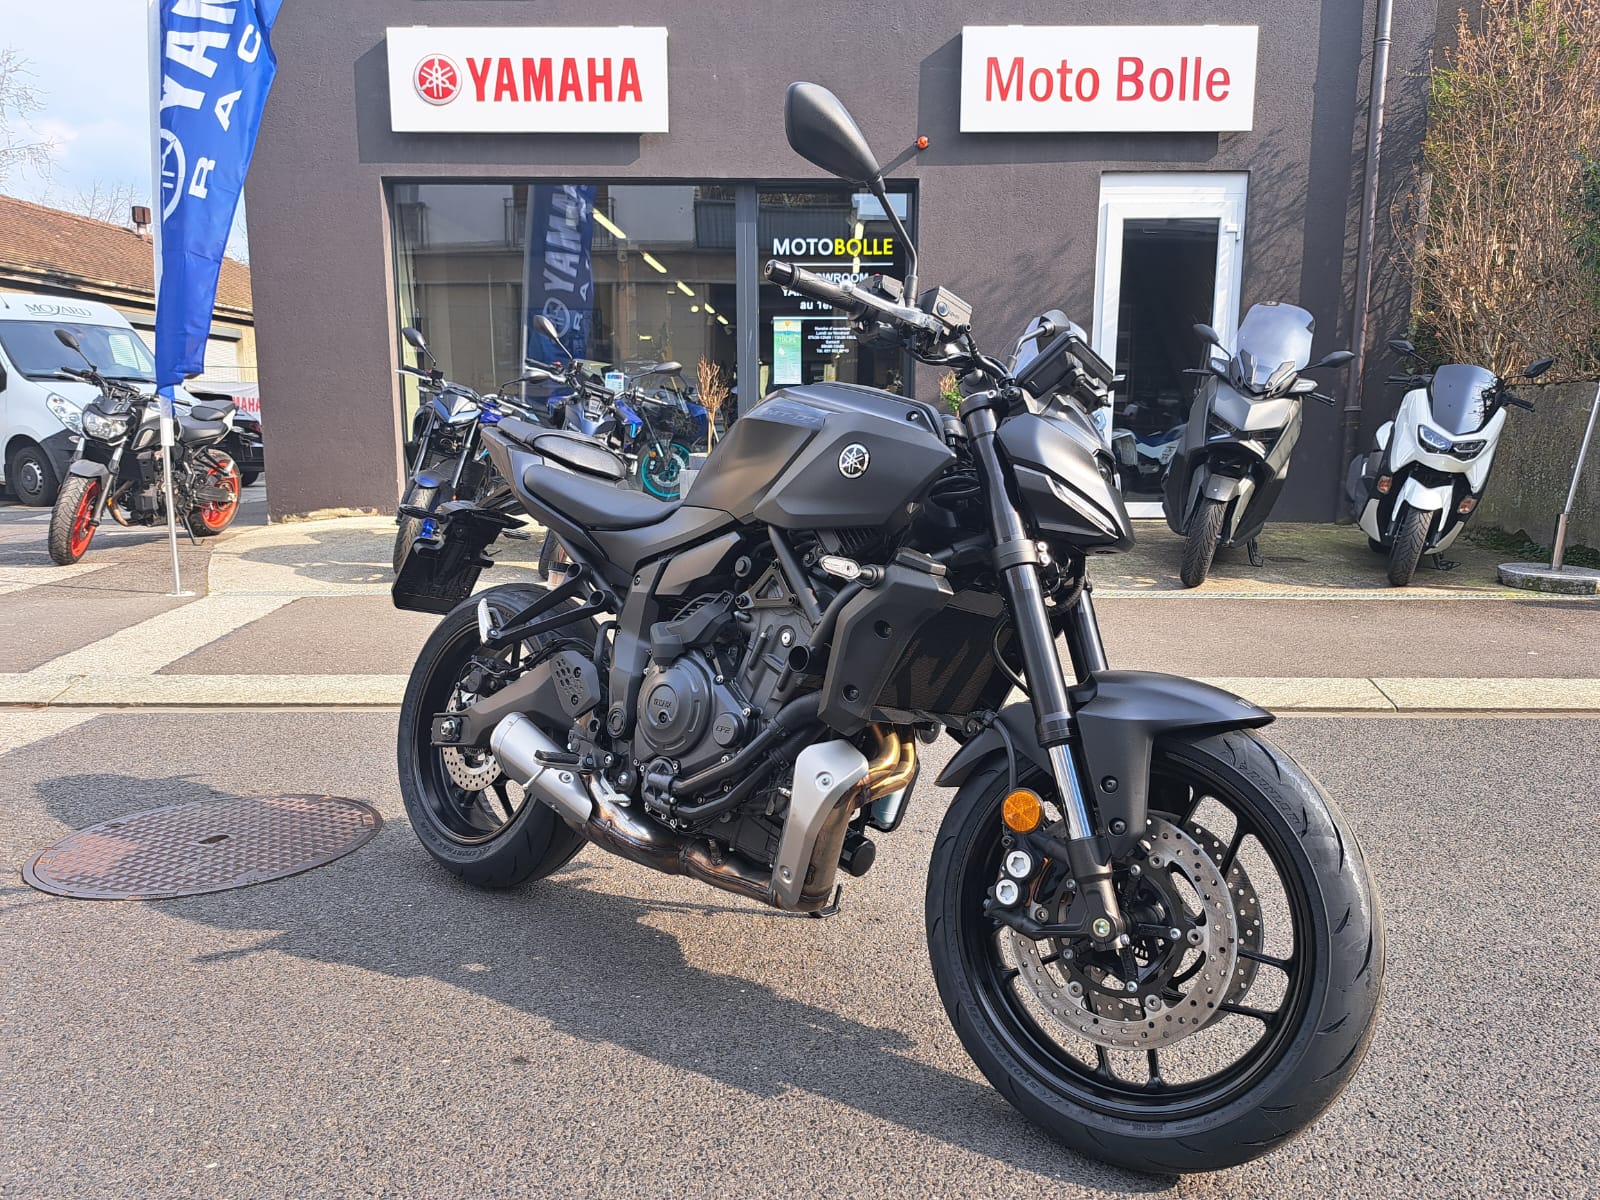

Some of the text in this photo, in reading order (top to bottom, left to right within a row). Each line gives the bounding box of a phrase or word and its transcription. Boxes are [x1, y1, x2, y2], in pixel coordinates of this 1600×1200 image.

[466, 57, 643, 102] YAMAHA
[985, 56, 1231, 102] Moto Bolle
[772, 237, 894, 256] MOTOBOLLE
[25, 303, 92, 318] MOYARD
[799, 301, 814, 310] au
